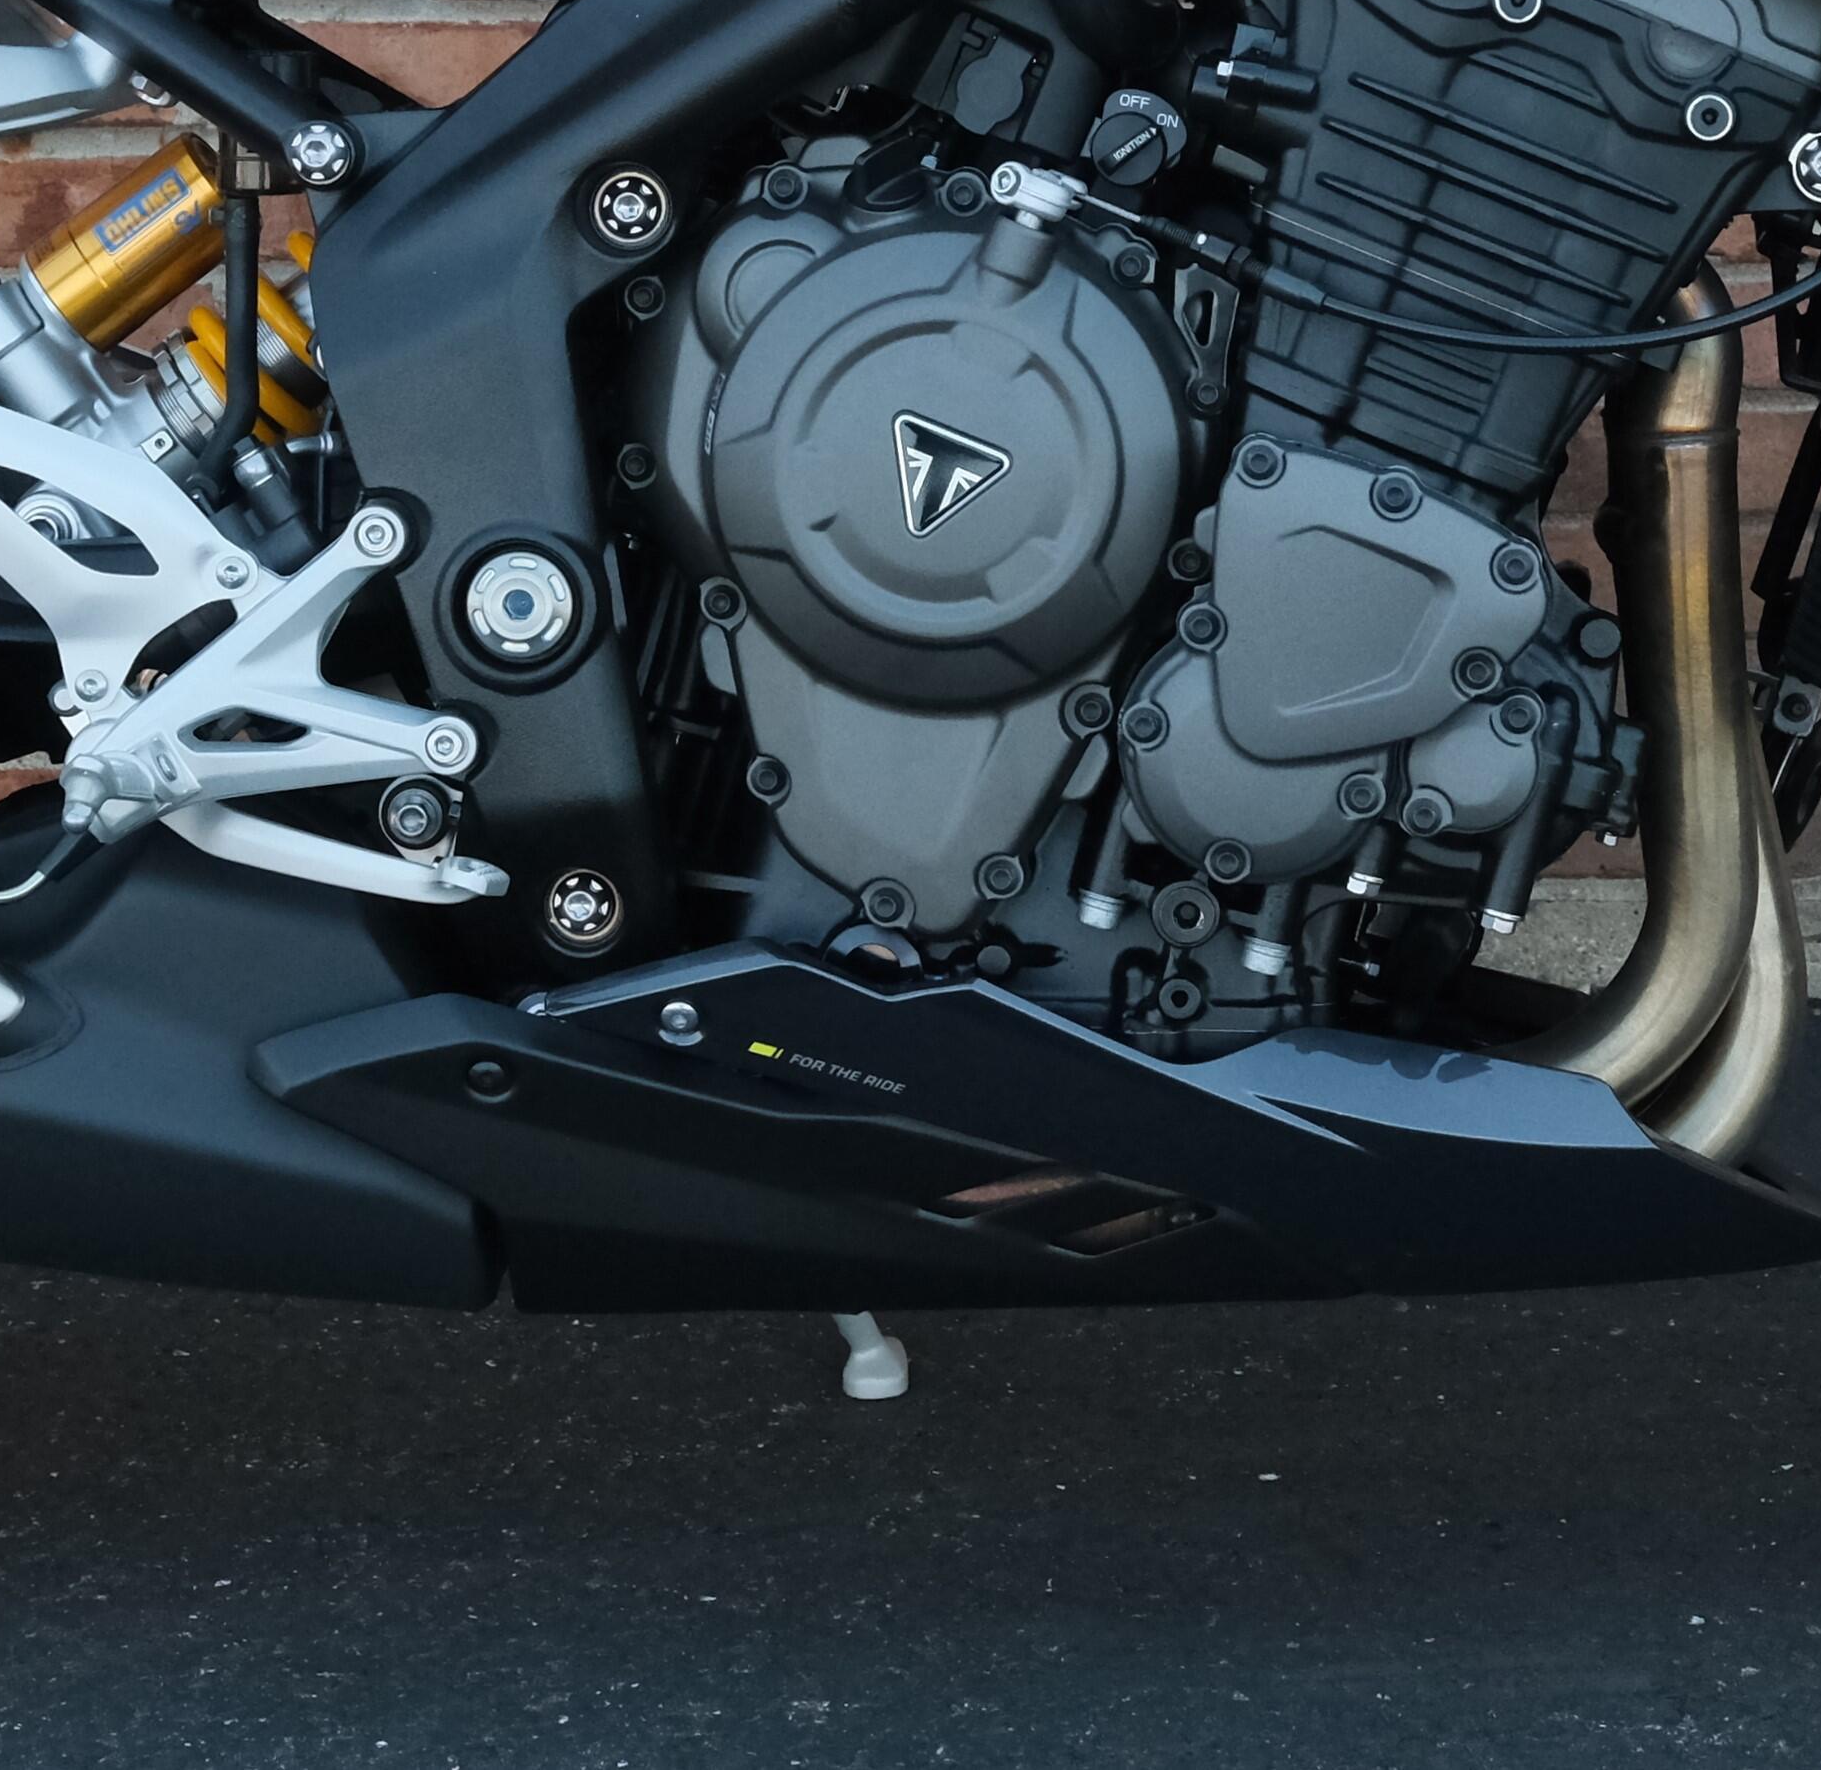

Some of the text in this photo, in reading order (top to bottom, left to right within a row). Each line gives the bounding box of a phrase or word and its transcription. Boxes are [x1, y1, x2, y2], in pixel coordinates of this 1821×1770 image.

[1119, 93, 1152, 110] OFF
[1156, 113, 1179, 129] ON
[1112, 129, 1152, 162] IGNITION
[102, 175, 183, 244] ÖHLINS
[788, 1053, 907, 1095] FOR THE RIDE
